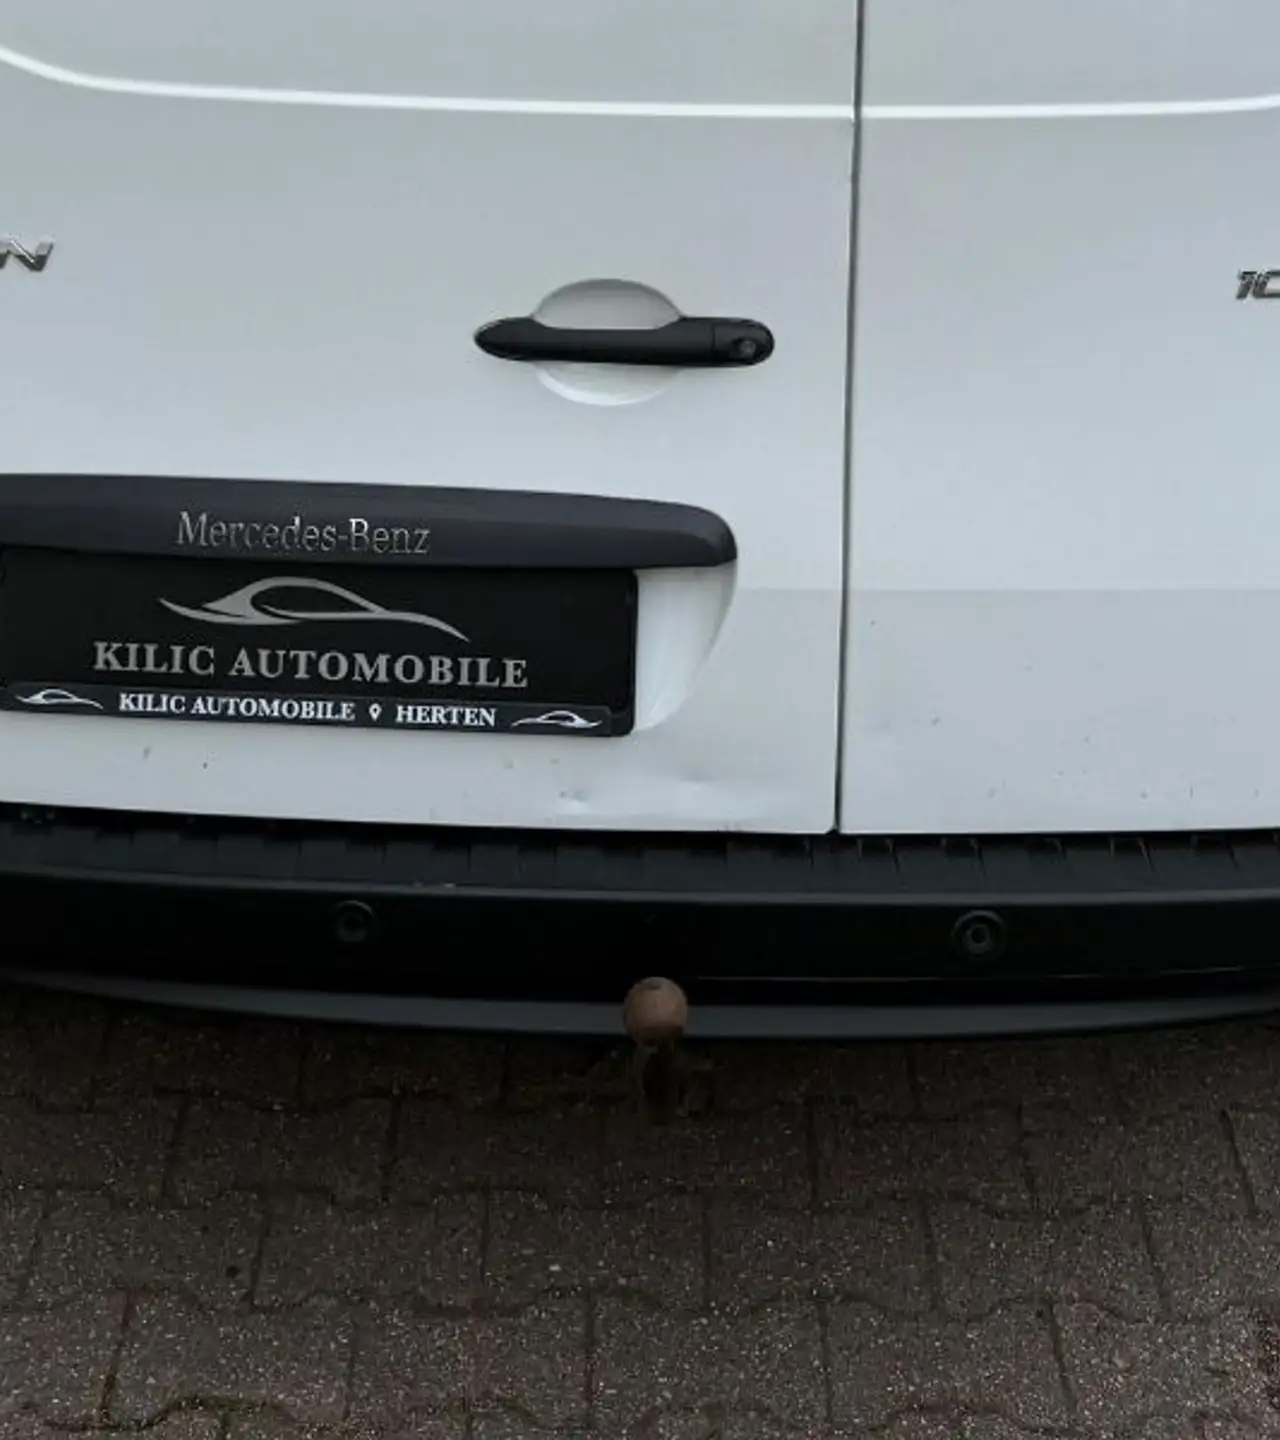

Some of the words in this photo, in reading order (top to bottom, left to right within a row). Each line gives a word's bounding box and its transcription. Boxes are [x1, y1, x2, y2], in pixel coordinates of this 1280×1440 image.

[176, 509, 431, 555] Mercedes-Benz
[93, 641, 216, 677] KILIC
[228, 645, 529, 689] AUTOMOBILE
[118, 692, 186, 715] KILIC
[189, 695, 357, 723] AUTOMOBILE
[395, 703, 498, 728] HERTEN
